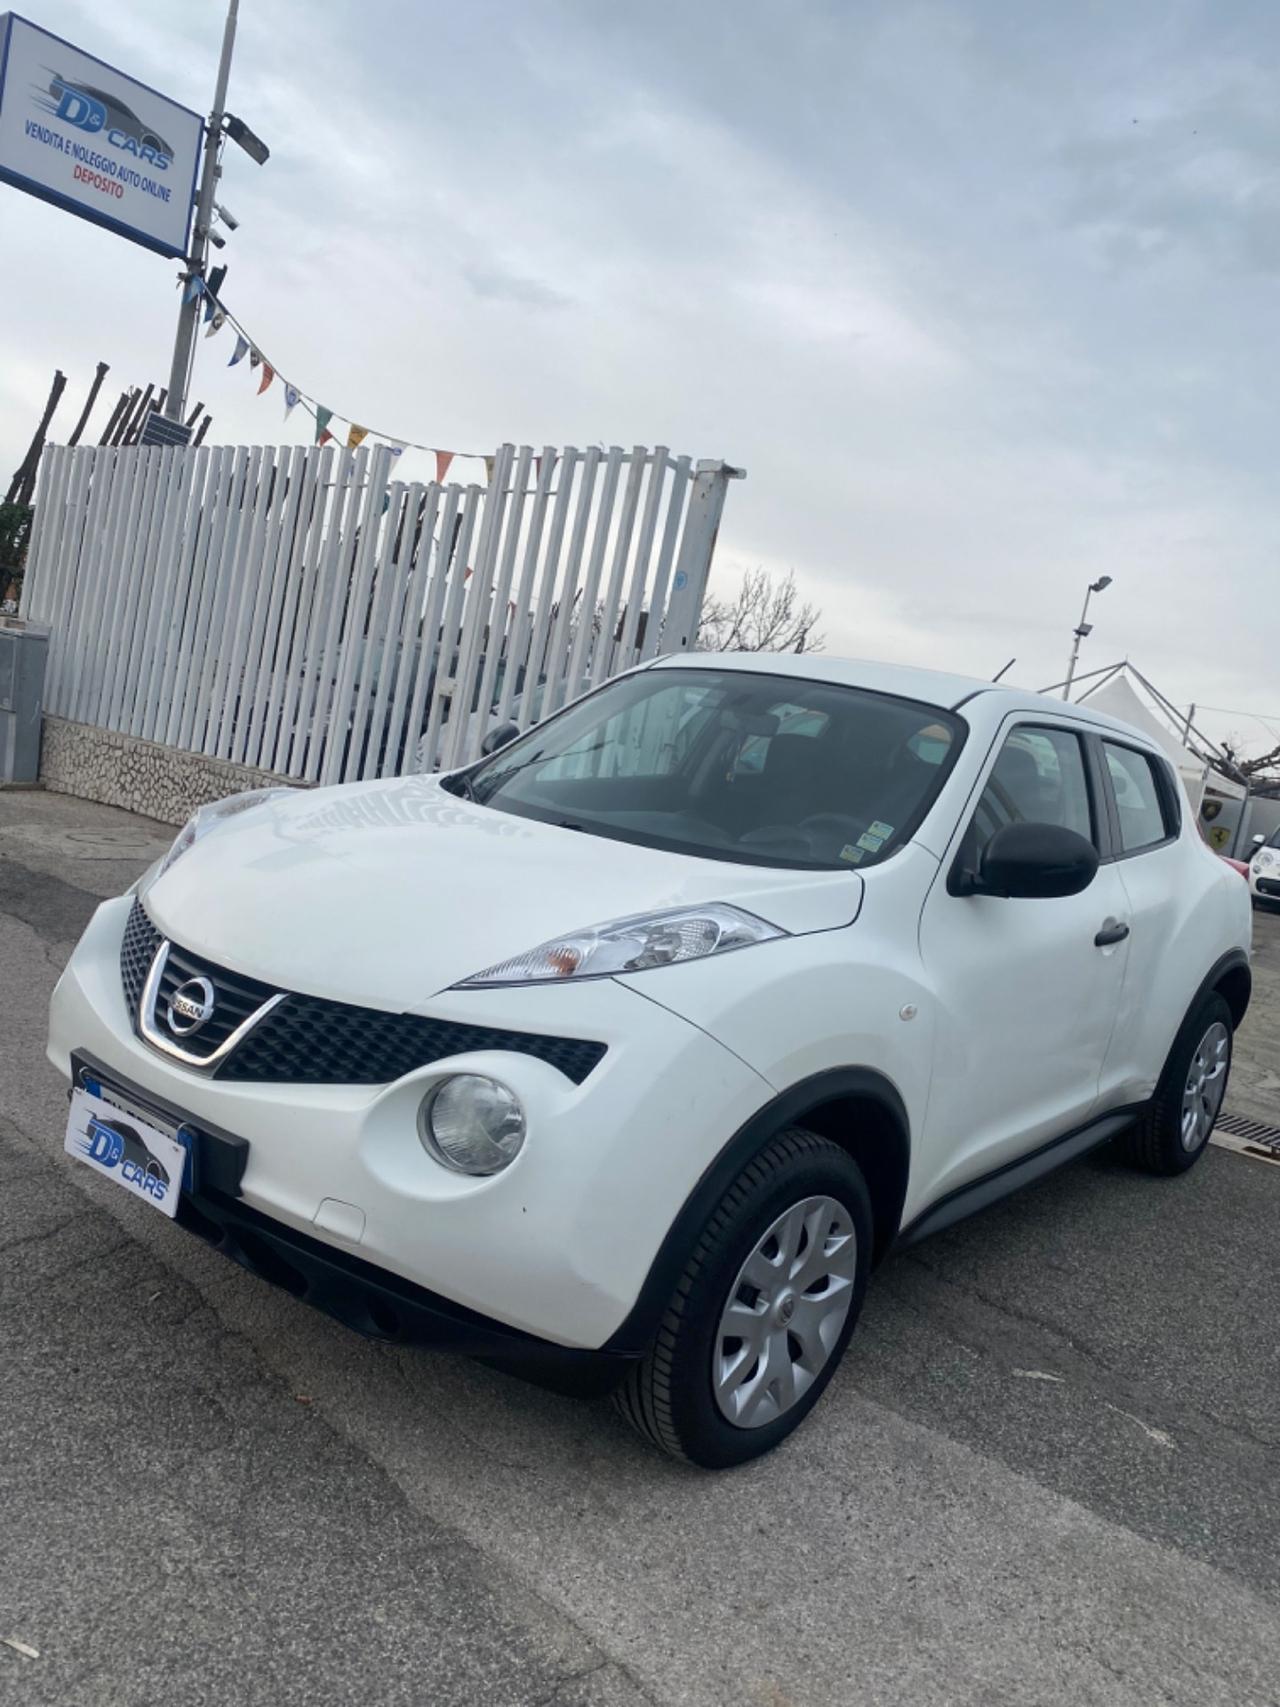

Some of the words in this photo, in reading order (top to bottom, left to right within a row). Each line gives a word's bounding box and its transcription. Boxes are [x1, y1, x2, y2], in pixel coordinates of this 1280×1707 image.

[25, 119, 64, 152] VENDITA
[64, 139, 72, 155] E
[72, 143, 117, 176] NOLEGGIO
[117, 166, 141, 188] AUTO
[141, 177, 172, 203] ONLINE
[107, 129, 170, 170] CARS
[73, 164, 124, 199] DEPOSITO
[171, 996, 204, 1018] SSAN
[121, 1160, 168, 1200] CARS
